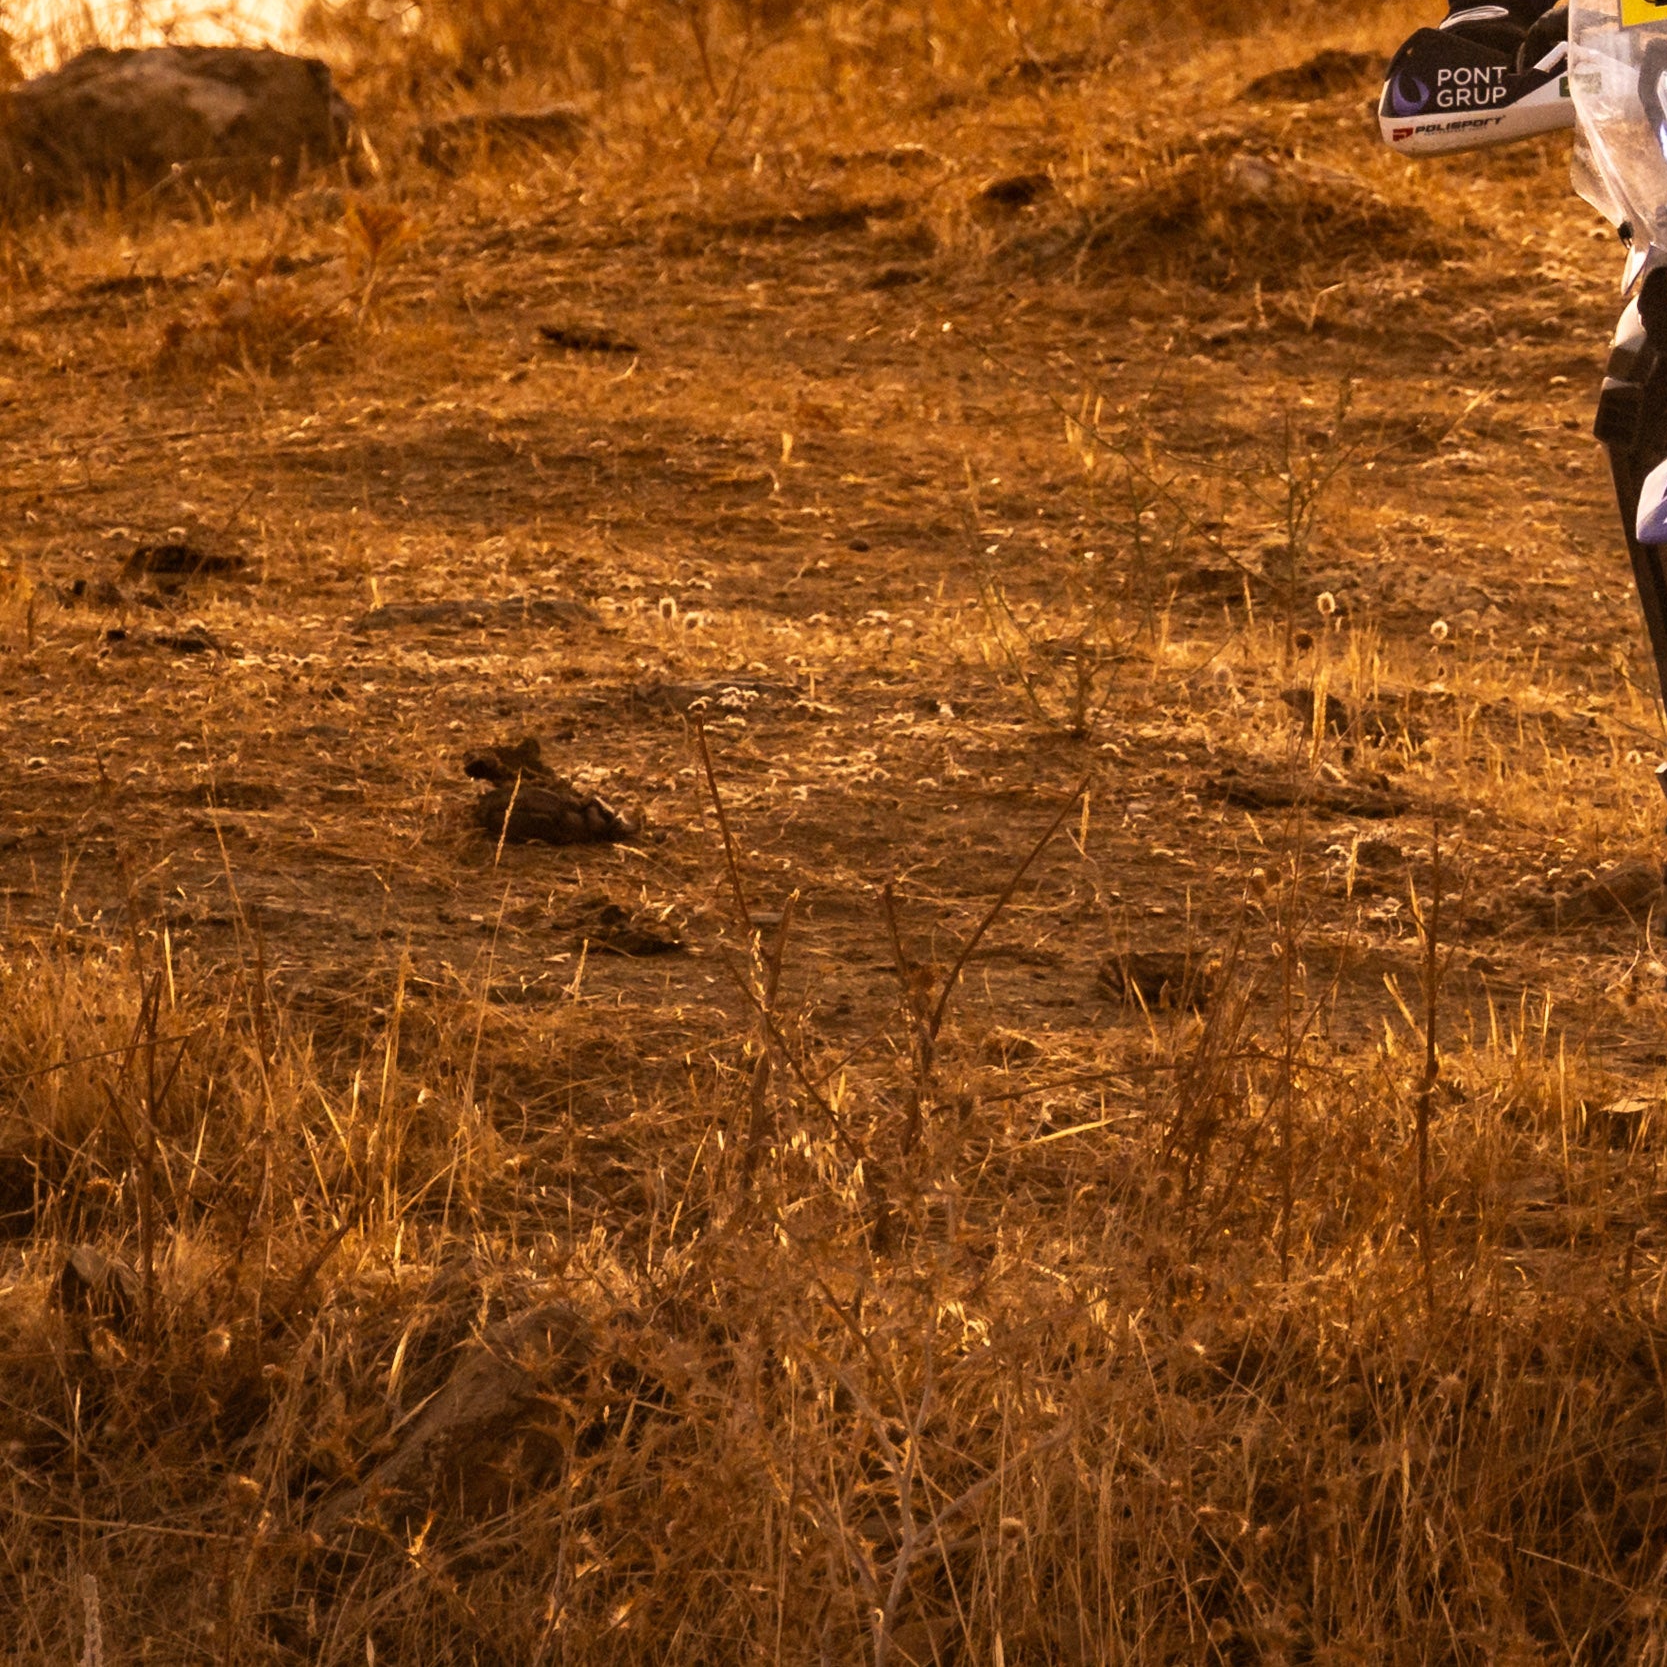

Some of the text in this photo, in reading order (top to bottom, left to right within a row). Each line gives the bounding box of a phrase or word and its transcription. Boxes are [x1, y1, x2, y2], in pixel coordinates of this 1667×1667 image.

[1437, 66, 1507, 86] PONT
[1436, 87, 1507, 107] GRUP
[1415, 116, 1503, 134] POLISPORT
